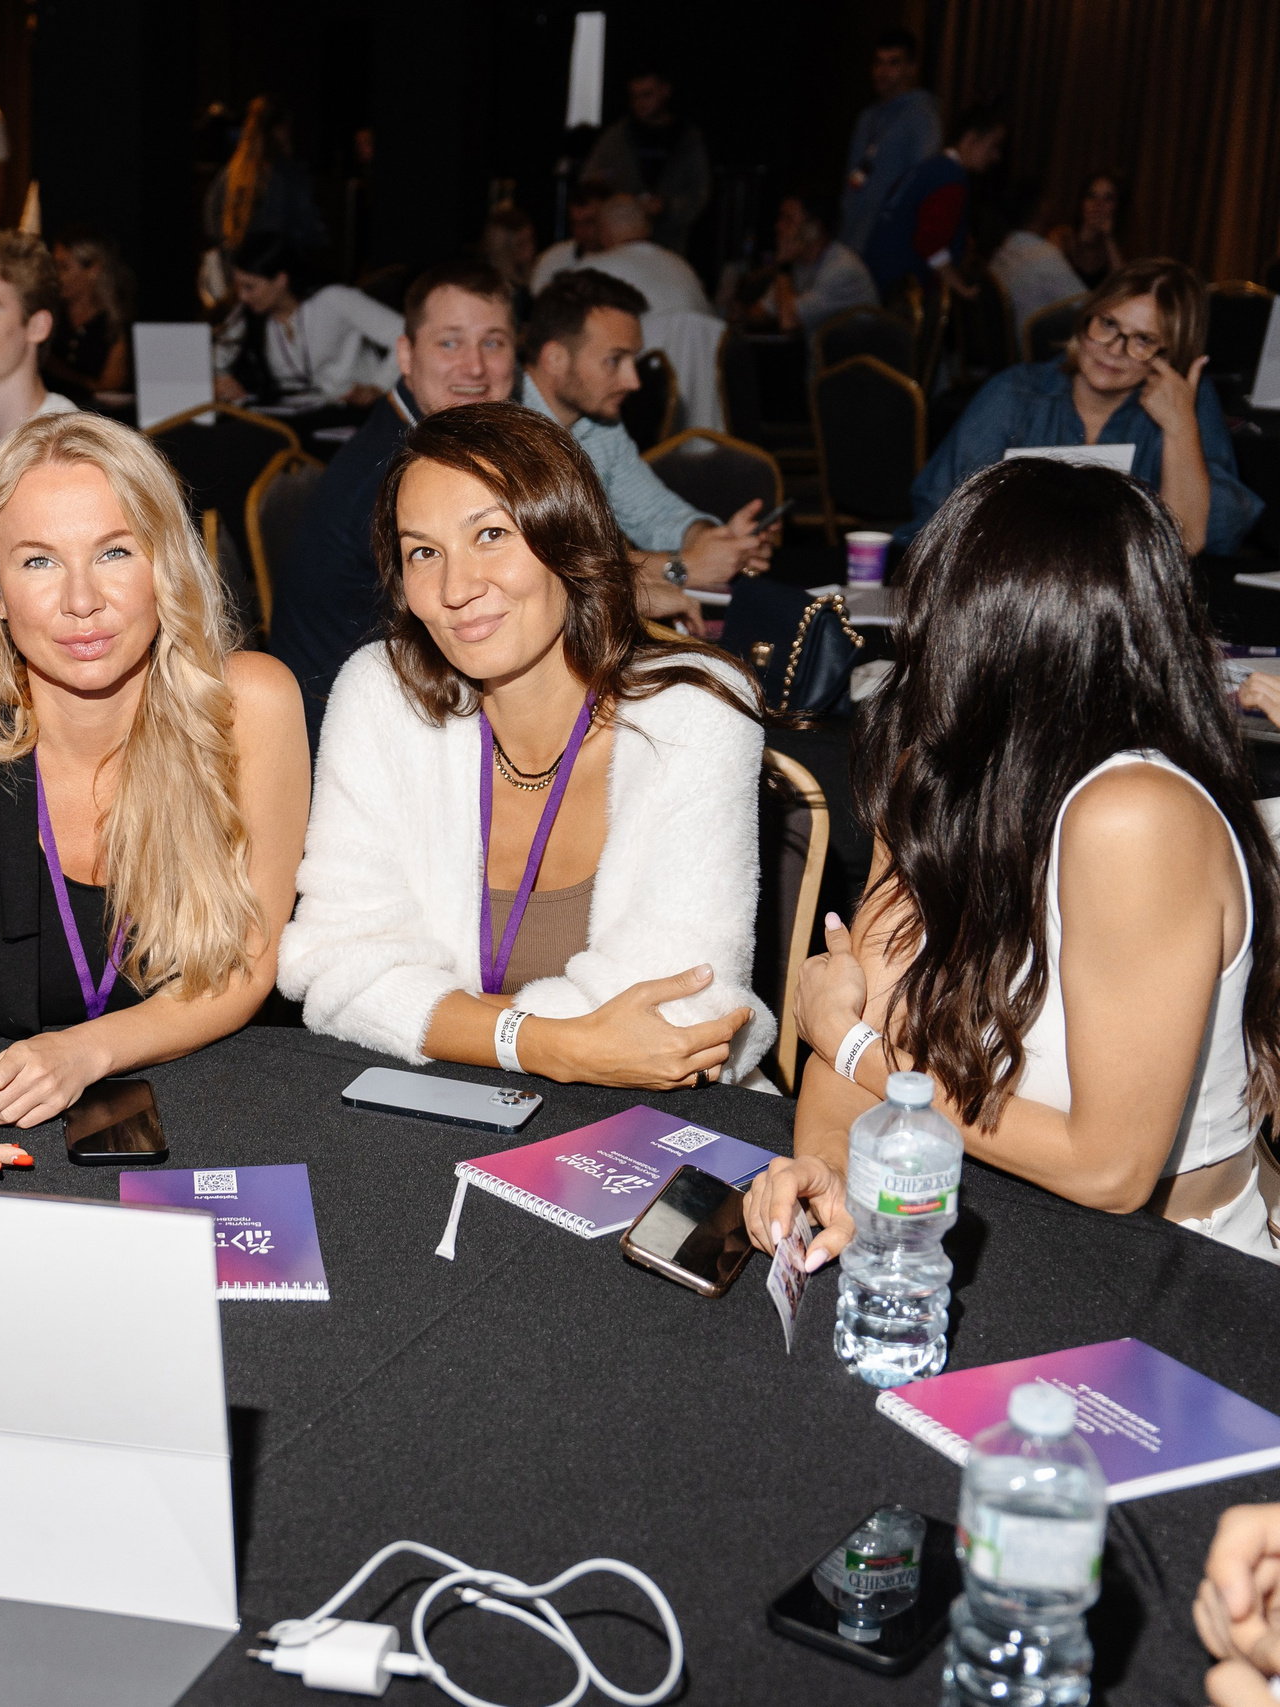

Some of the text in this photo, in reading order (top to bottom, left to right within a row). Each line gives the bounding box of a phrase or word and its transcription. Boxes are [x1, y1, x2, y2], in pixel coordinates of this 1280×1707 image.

[507, 1022, 517, 1044] CLUB
[844, 1030, 874, 1077] AFTERPART
[555, 1154, 605, 1179] ТОПАЙ
[570, 1153, 605, 1171] ТОП
